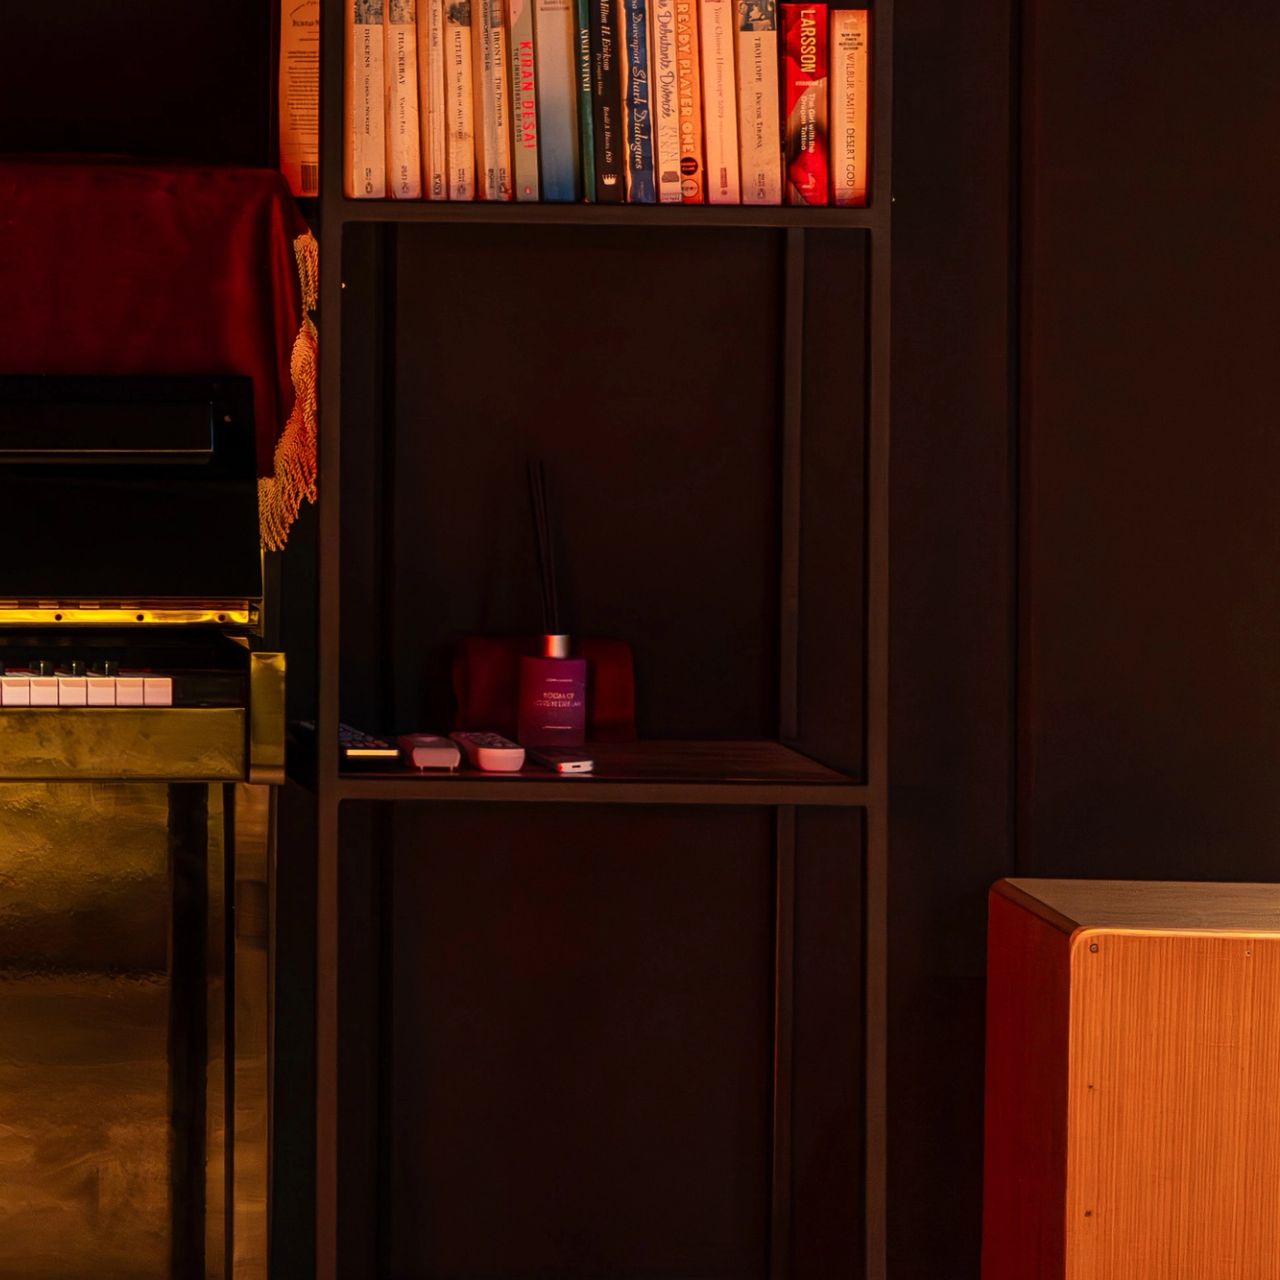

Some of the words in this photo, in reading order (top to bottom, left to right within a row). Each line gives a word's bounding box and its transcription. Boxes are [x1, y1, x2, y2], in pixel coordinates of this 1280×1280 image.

[631, 14, 643, 64] Davenport
[801, 10, 816, 72] LARSSON
[521, 42, 535, 90] KIRAN
[632, 67, 646, 105] Shark
[846, 53, 854, 89] WILBUR
[522, 101, 535, 148] DESAI
[846, 93, 854, 123] SMITH
[631, 108, 648, 168] Dialogues
[846, 128, 855, 160] DESERT
[846, 164, 855, 187] GOD
